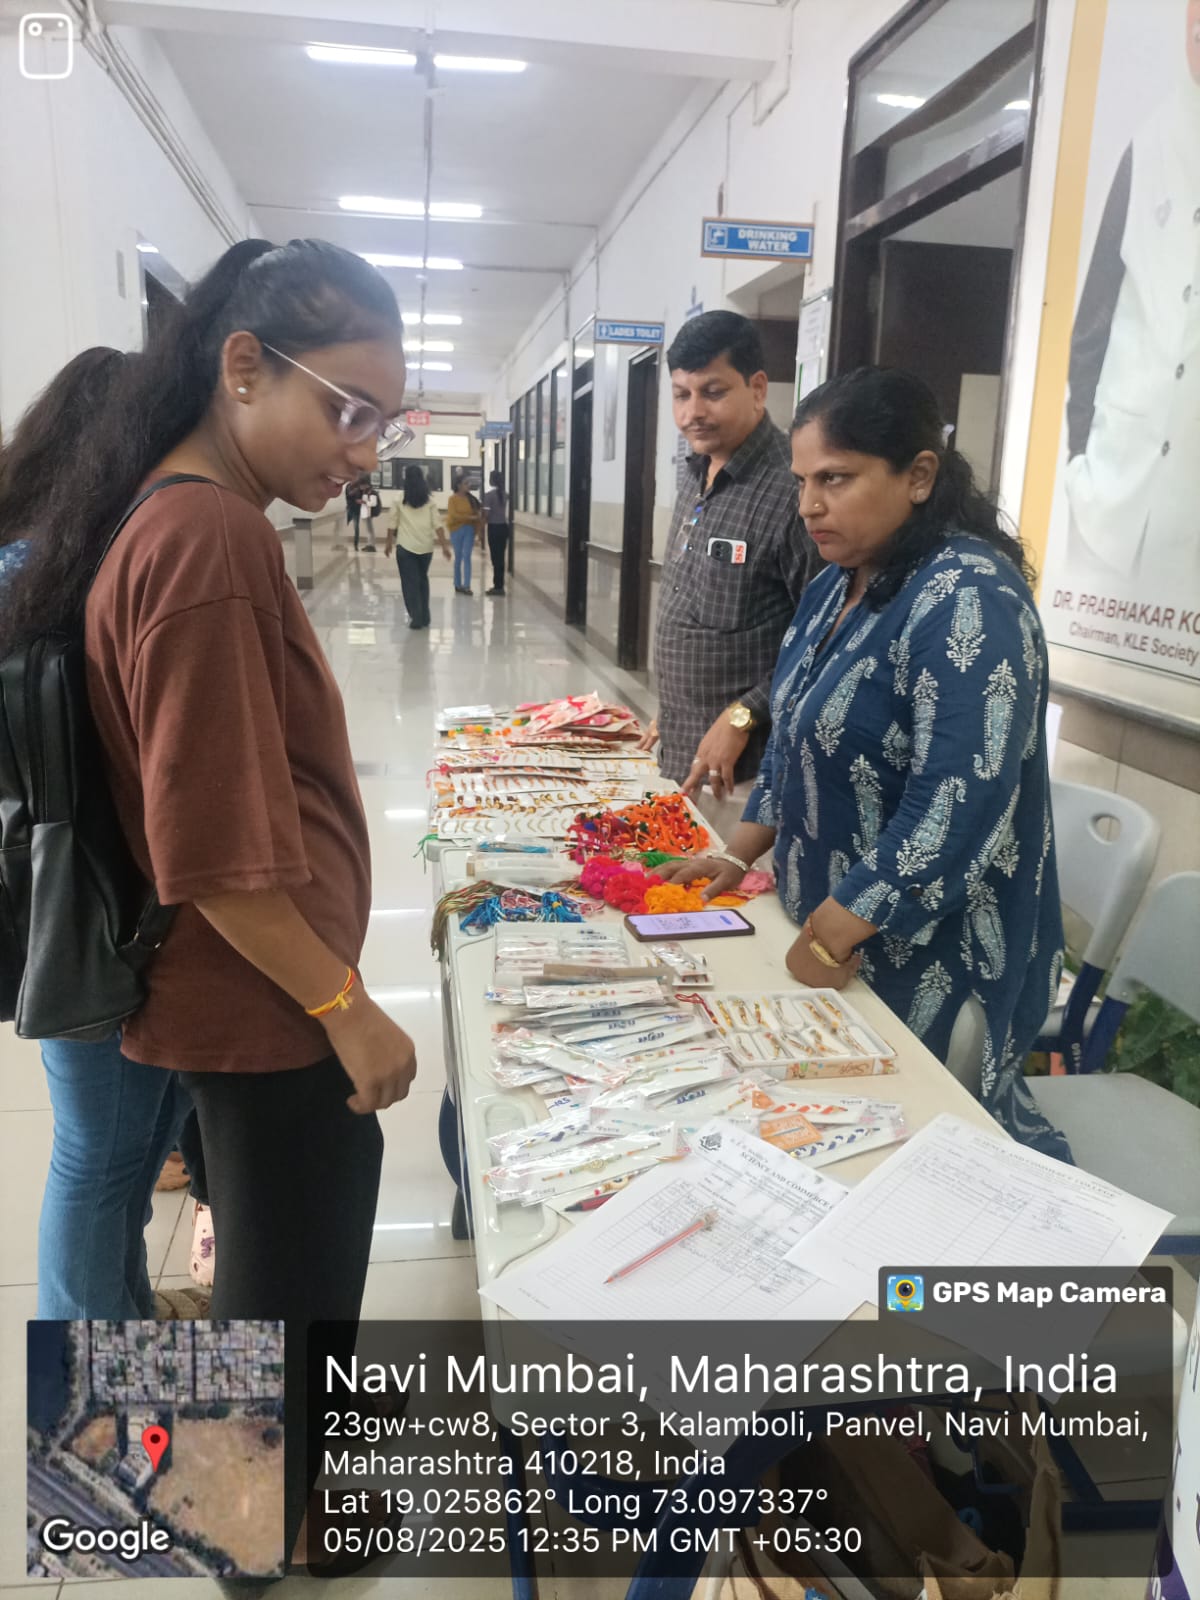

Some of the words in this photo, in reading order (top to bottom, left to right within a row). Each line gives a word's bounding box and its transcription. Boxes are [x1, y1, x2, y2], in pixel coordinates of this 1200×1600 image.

[738, 228, 798, 242] DRINKING
[748, 240, 790, 252] WATER
[1052, 589, 1073, 611] DR.
[1077, 593, 1176, 630] PRABHAKAR
[1069, 621, 1120, 648] Chairman,
[1123, 632, 1149, 652] KLE
[1151, 637, 1199, 667] Society
